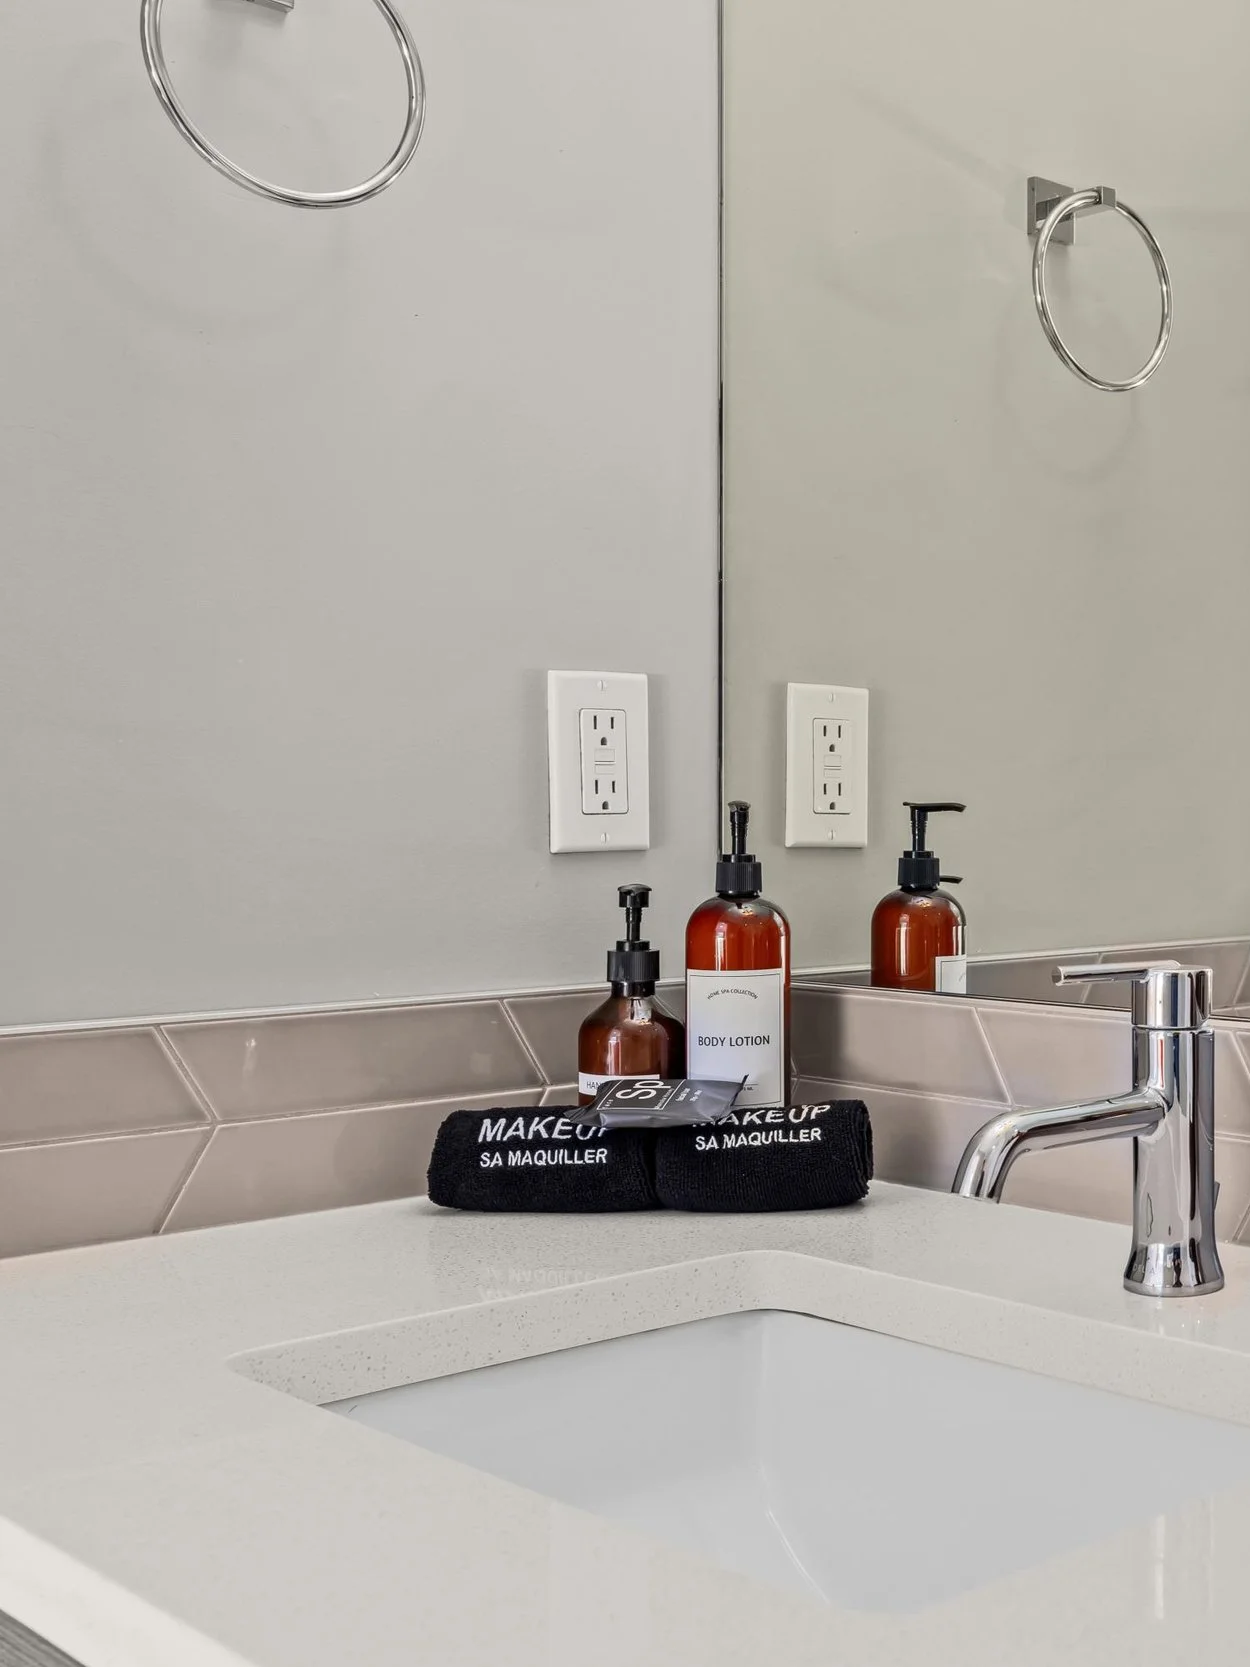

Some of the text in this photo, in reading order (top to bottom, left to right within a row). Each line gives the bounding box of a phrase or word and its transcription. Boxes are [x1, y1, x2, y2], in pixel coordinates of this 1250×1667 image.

[730, 988, 758, 1000] COLLECTION
[698, 1034, 770, 1047] BODY LOTION
[692, 1104, 831, 1128] AKEUP
[695, 1127, 822, 1151] SA MAQUILLER
[479, 1148, 608, 1168] SA MAQUILLER
